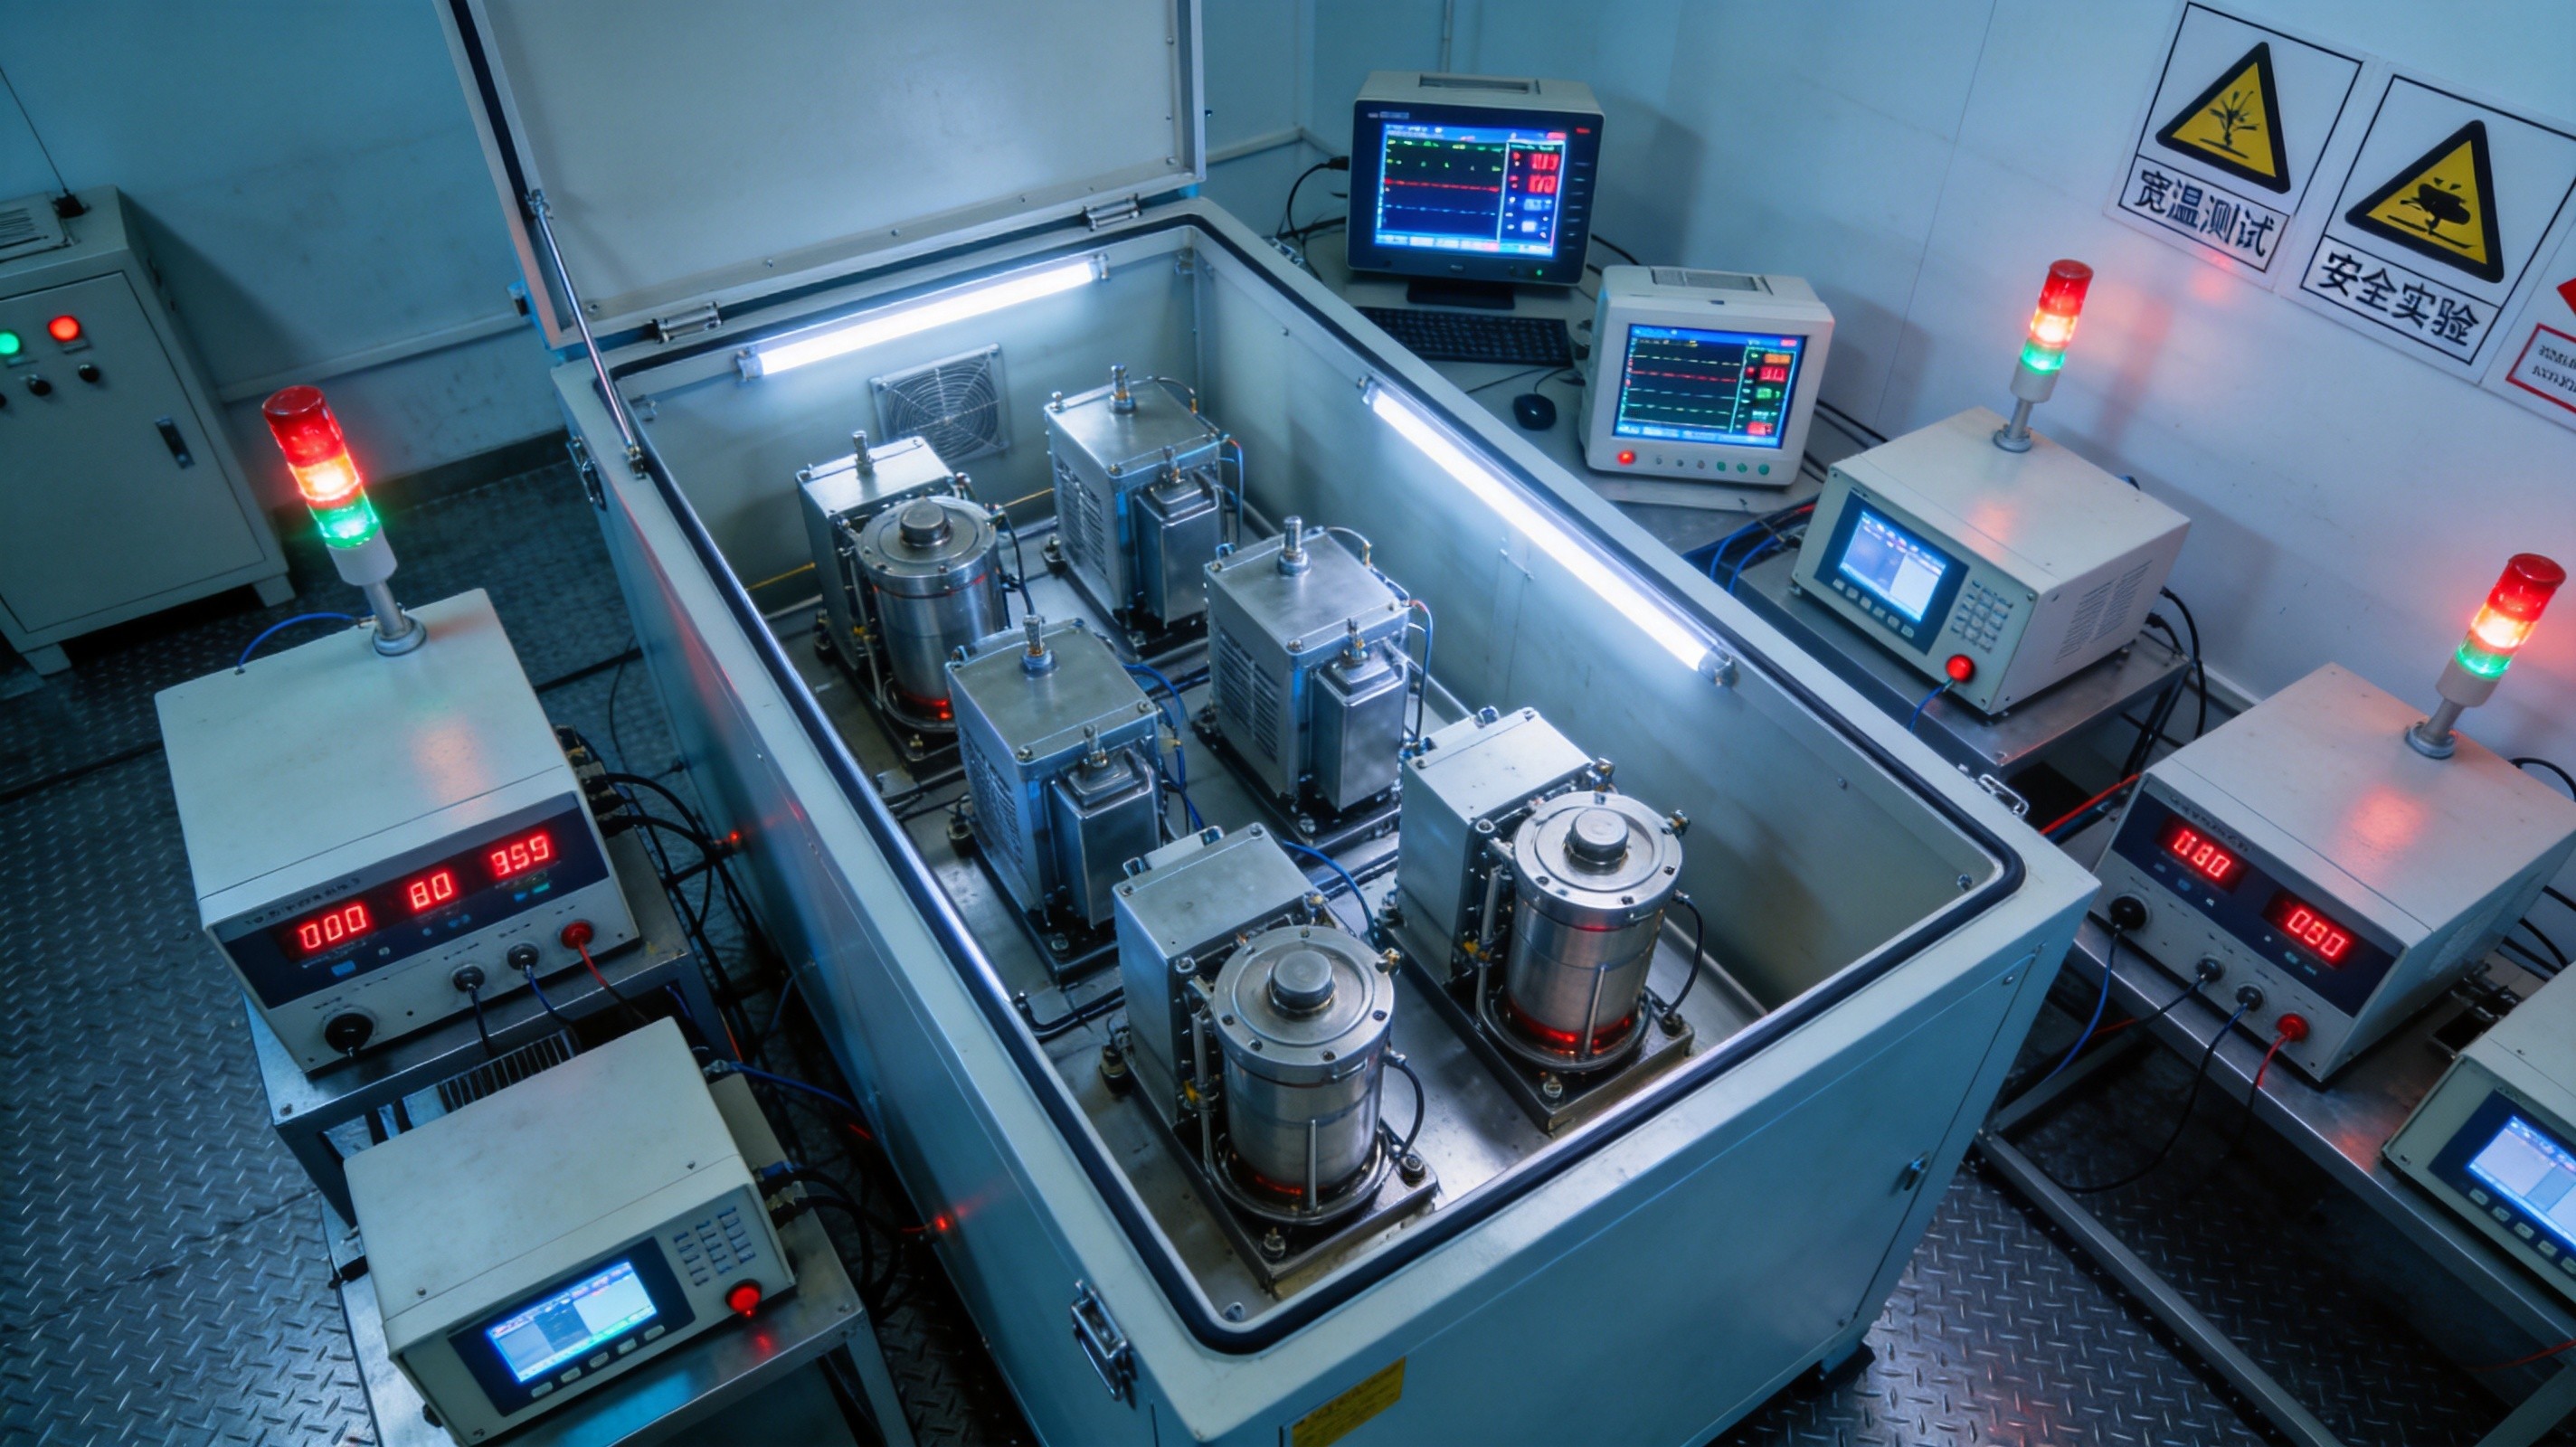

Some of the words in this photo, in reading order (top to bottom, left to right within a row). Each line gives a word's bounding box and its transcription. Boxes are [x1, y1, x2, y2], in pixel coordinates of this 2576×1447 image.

[2134, 169, 2275, 258] 宽温测试
[2318, 251, 2479, 346] 安全实验
[410, 871, 452, 910] 80
